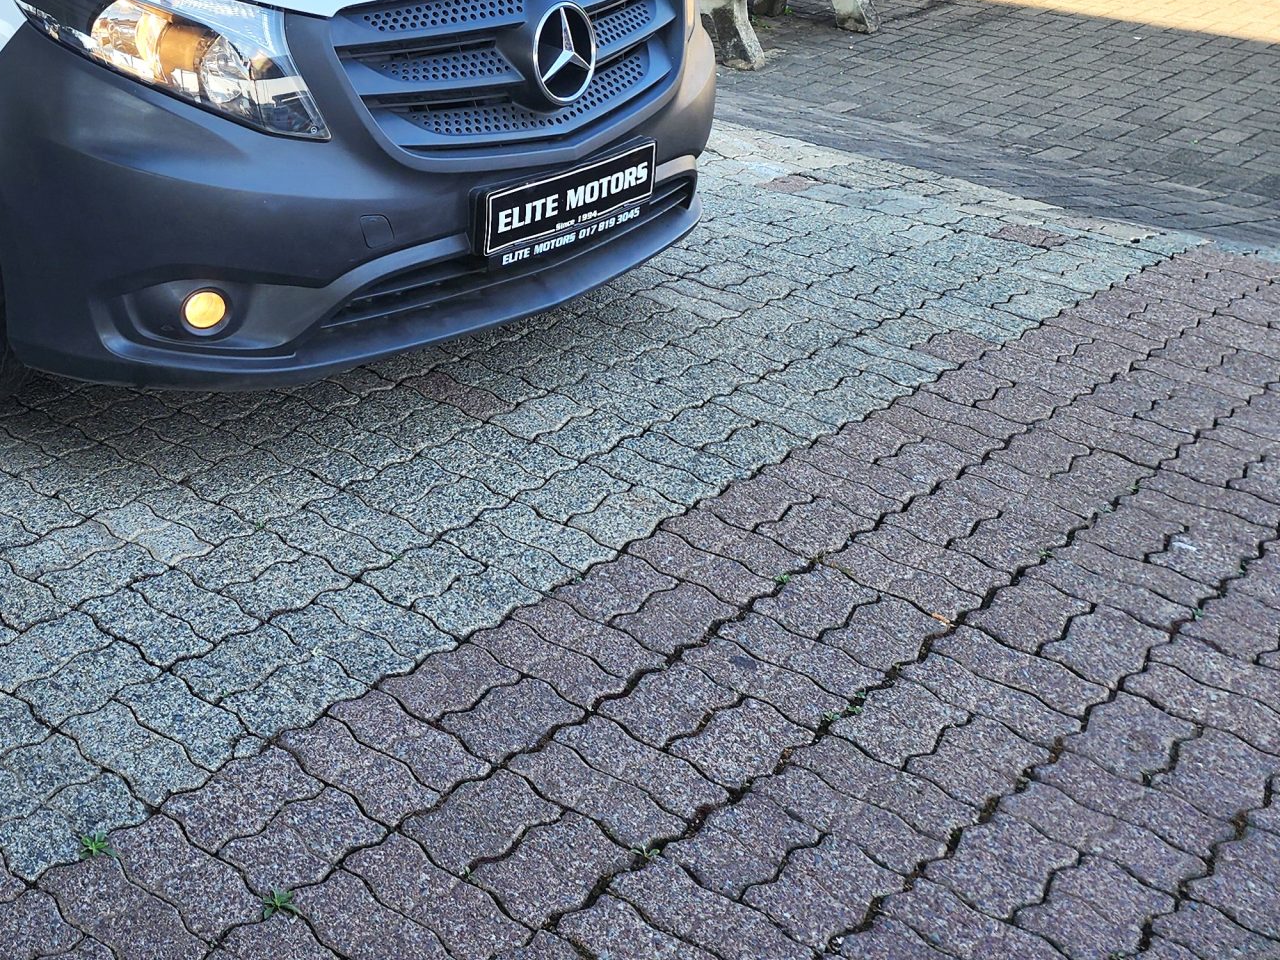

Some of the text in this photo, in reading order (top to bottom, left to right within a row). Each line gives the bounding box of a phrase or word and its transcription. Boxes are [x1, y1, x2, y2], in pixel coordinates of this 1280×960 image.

[497, 161, 649, 234] ELITE MOTORS
[555, 210, 598, 232] Since 1994
[501, 206, 641, 266] ELITE MOTORS 017 819 3045
